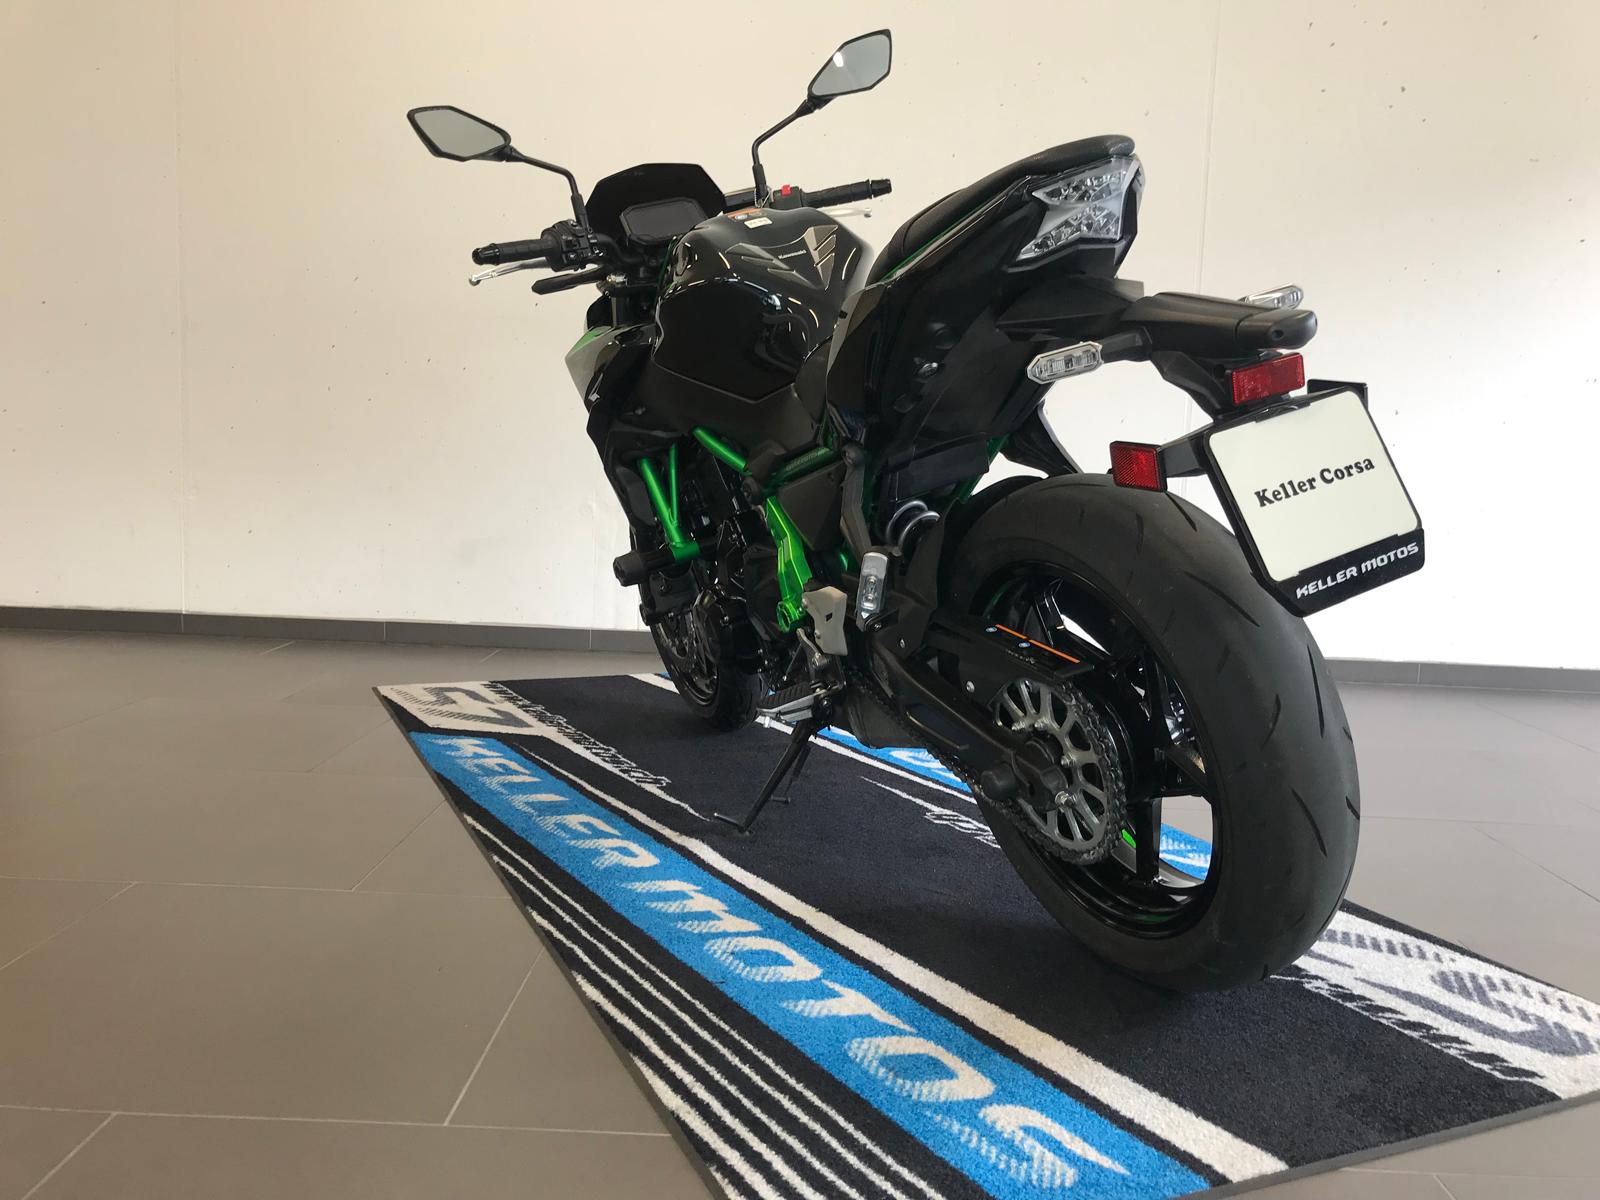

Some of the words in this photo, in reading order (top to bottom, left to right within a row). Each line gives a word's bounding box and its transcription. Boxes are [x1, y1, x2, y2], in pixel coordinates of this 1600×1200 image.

[1254, 476, 1317, 507] Keller
[1320, 458, 1375, 484] Corsa
[1295, 566, 1358, 599] KELLER
[1361, 542, 1419, 573] MOTOS
[430, 736, 661, 870] KELLER
[621, 878, 1132, 1190] MOTOS
